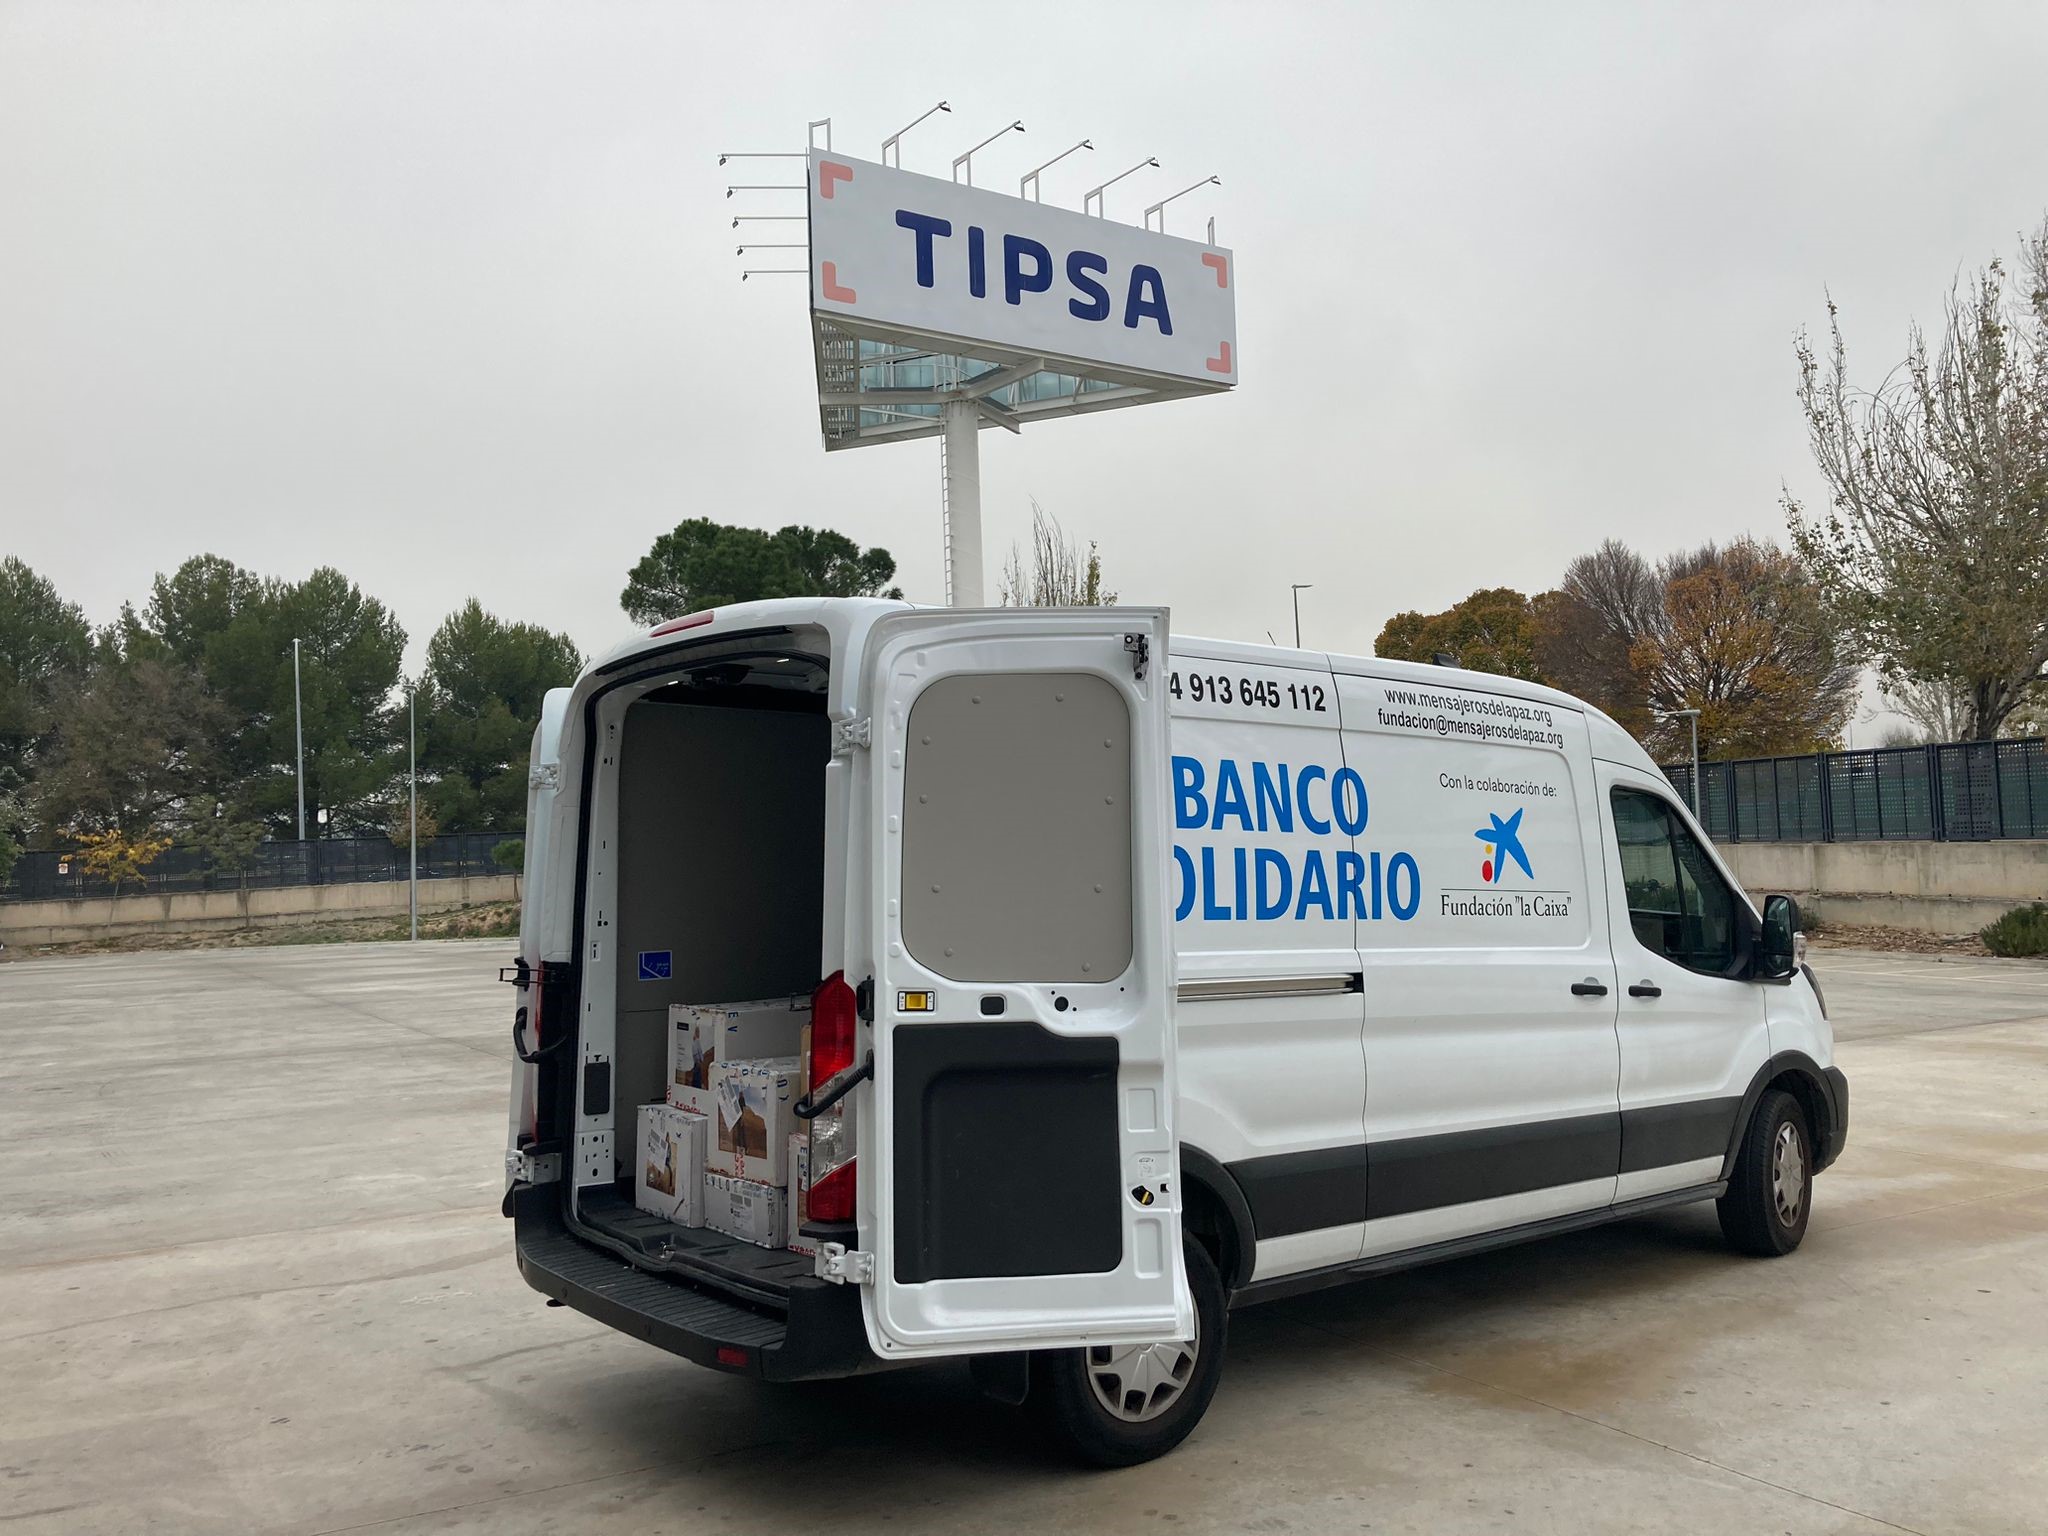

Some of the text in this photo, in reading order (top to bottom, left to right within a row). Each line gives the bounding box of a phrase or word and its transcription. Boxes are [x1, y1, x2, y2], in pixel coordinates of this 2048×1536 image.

[895, 209, 1173, 336] TIPSA
[1189, 673, 1233, 705] 913
[1239, 678, 1281, 709] 645
[1287, 683, 1327, 712] 112
[1384, 689, 1553, 727] www.mensajerosdelapaz.org
[1377, 708, 1564, 750] fundacion@mensajerosdelapaz.org
[1171, 755, 1369, 838] BANCO
[1439, 772, 1557, 797] Con la colaboración de:
[1440, 894, 1572, 917] Fundación "la Caixa"
